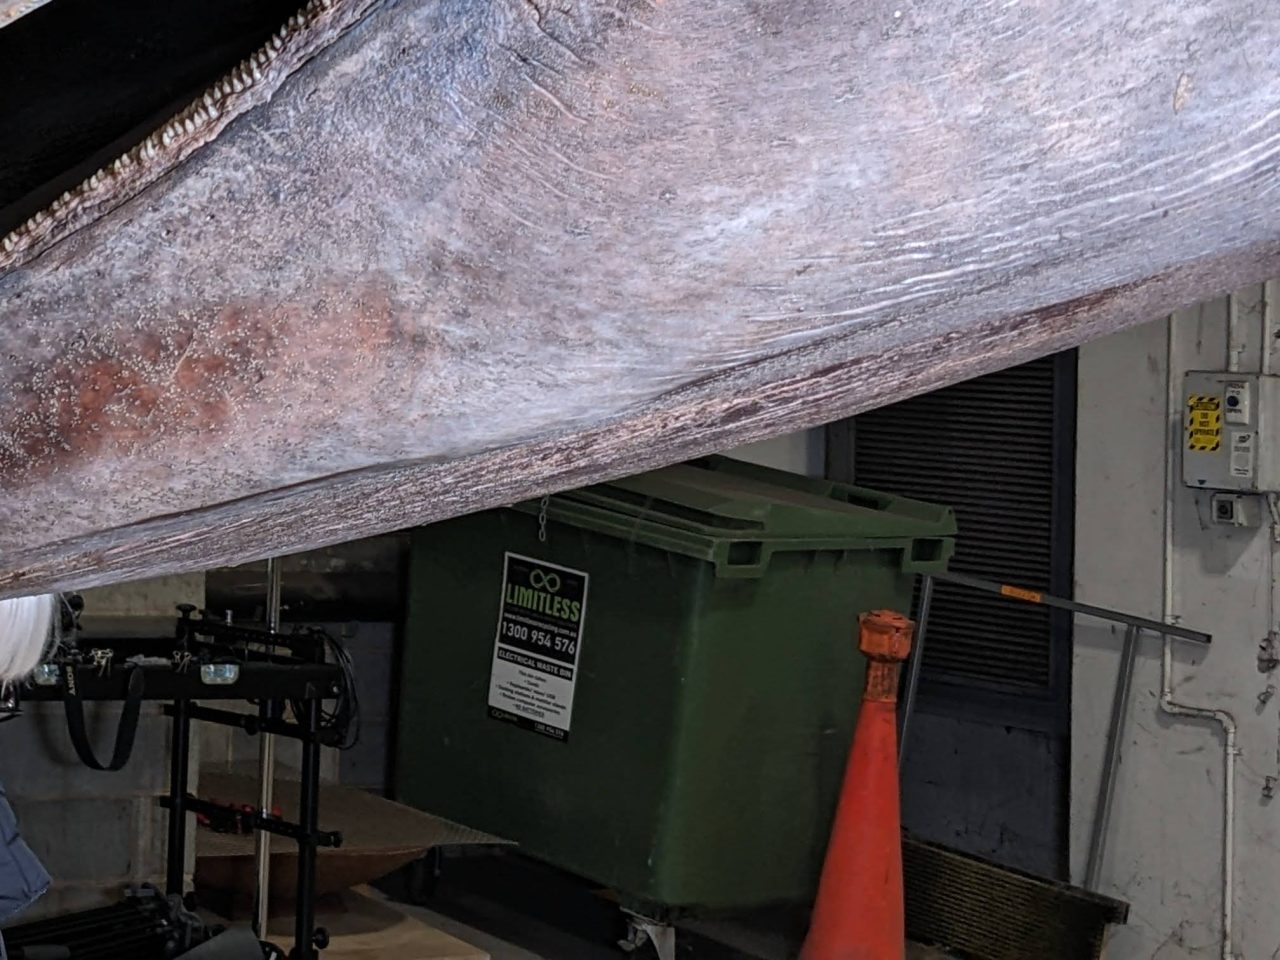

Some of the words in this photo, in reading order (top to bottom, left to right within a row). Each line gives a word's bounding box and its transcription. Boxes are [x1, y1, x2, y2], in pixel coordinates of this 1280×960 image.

[506, 582, 581, 622] LIMITLESS
[501, 621, 528, 641] 1300
[531, 629, 552, 648] 954
[554, 636, 575, 655] 576
[498, 650, 535, 669] ELECTRICAL
[536, 661, 559, 674] WASTE
[559, 667, 572, 678] BIN
[65, 665, 76, 696] SONY
